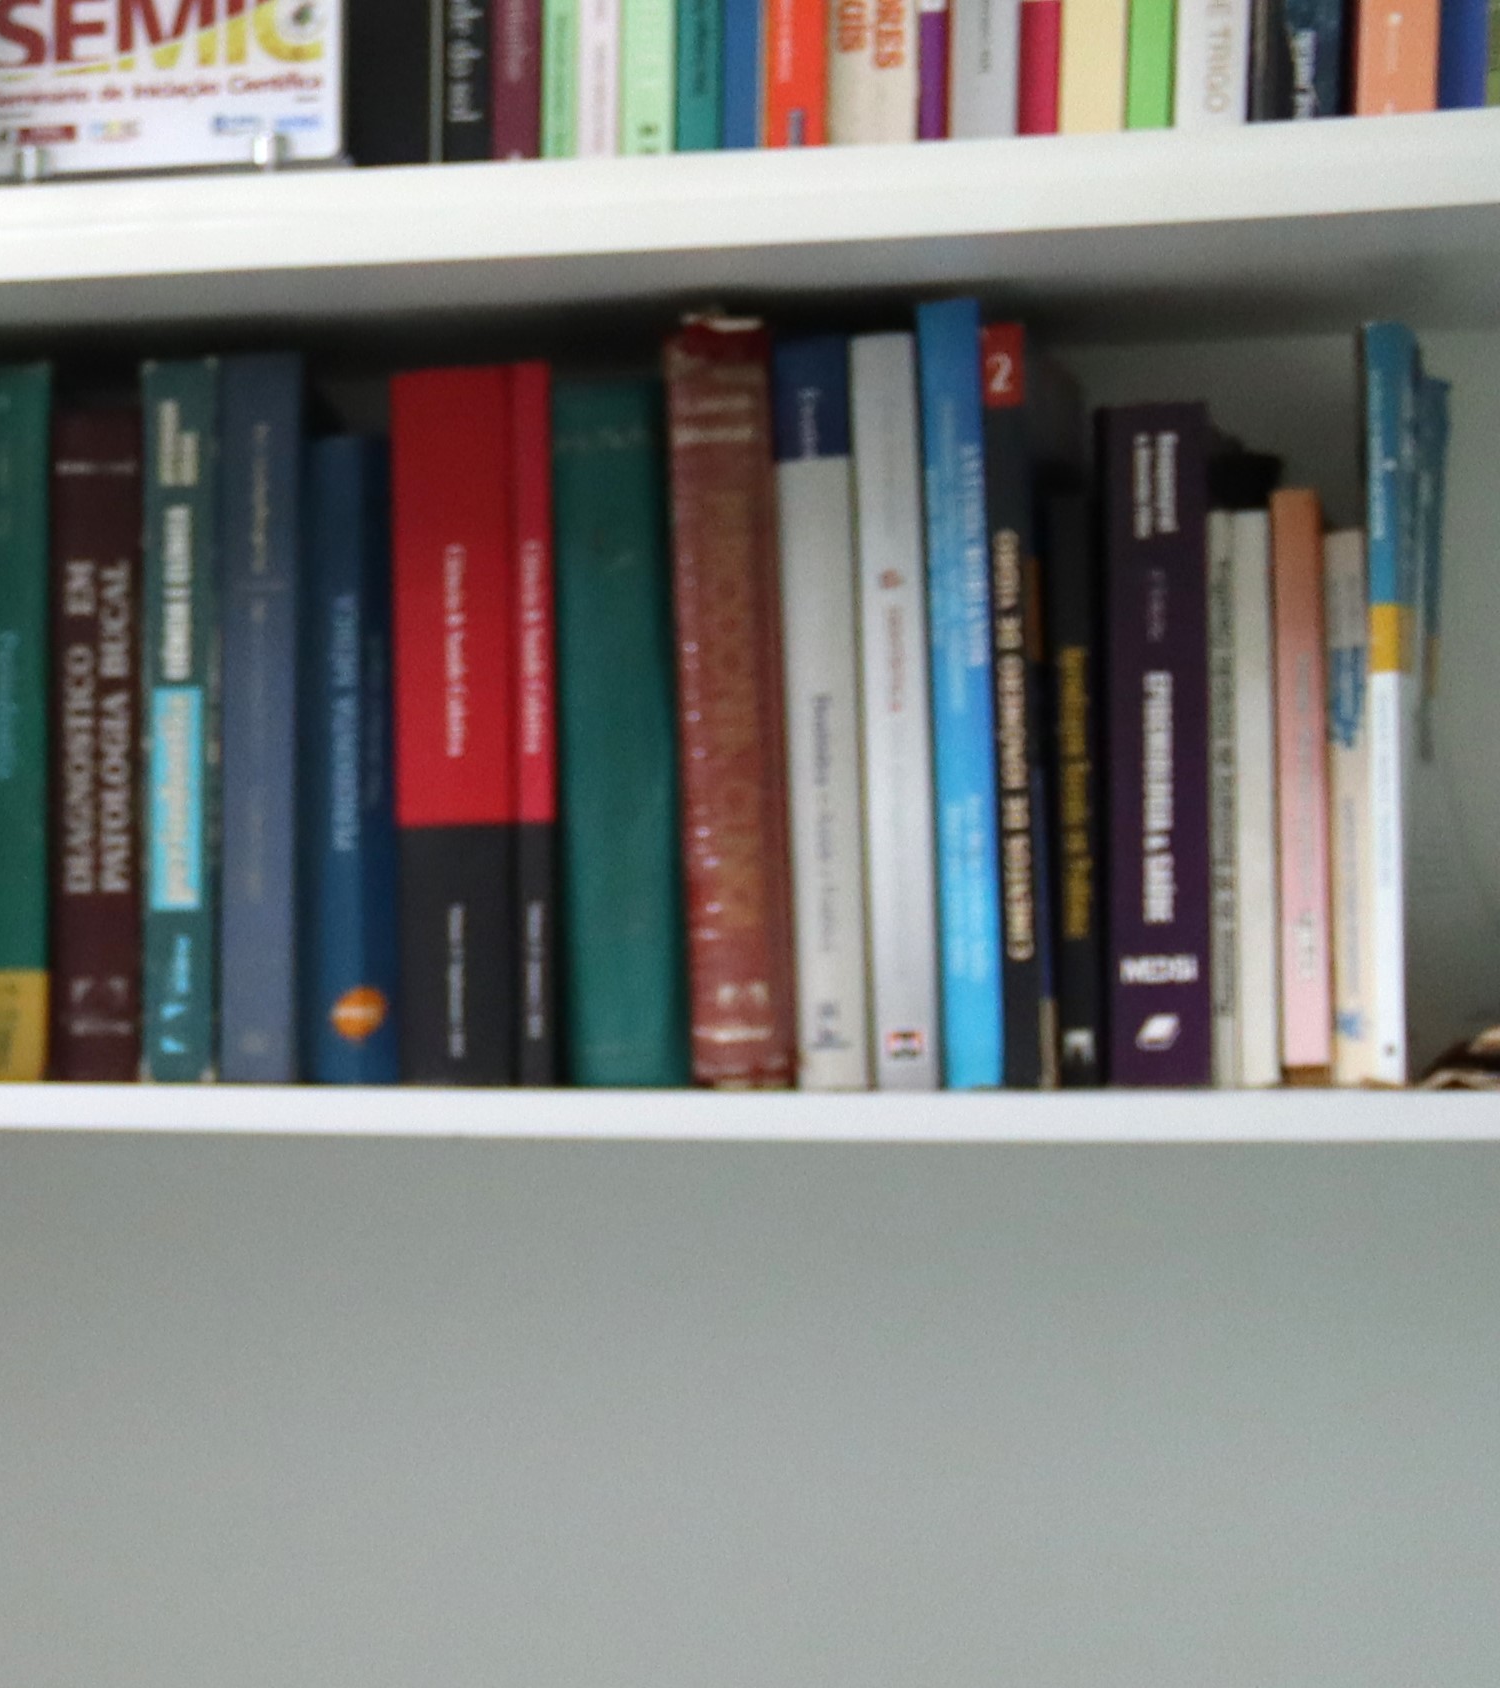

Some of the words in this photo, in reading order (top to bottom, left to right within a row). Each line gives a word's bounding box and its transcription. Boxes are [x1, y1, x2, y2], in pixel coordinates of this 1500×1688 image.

[99, 558, 133, 679] BUCAL
[997, 614, 1024, 650] DE
[99, 690, 133, 895] PATOLOGIA
[1002, 793, 1030, 831] DE
